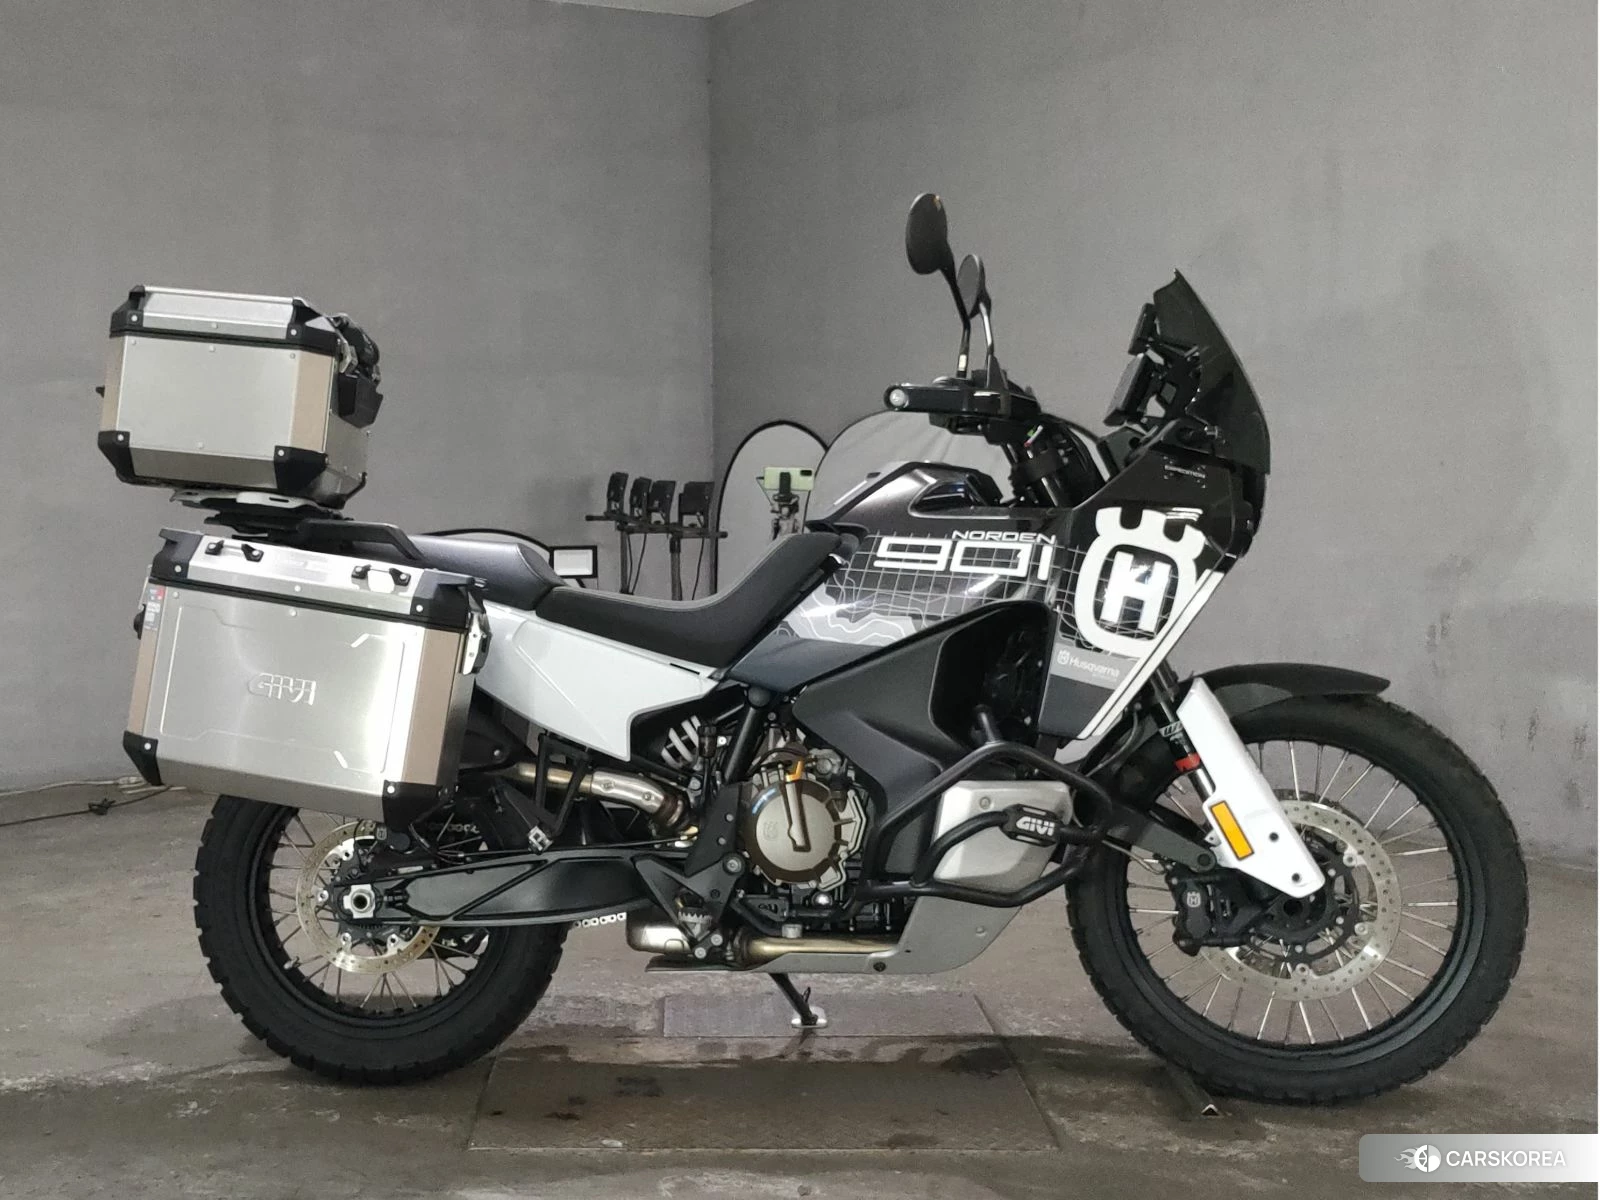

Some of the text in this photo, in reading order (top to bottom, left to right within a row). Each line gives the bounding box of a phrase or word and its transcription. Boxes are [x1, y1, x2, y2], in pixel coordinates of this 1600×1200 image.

[952, 530, 1056, 545] NORDEN
[873, 536, 1053, 581] 901
[1069, 655, 1121, 678] Husqvarna
[247, 672, 316, 705] GIVI
[1016, 816, 1055, 836] GIVI
